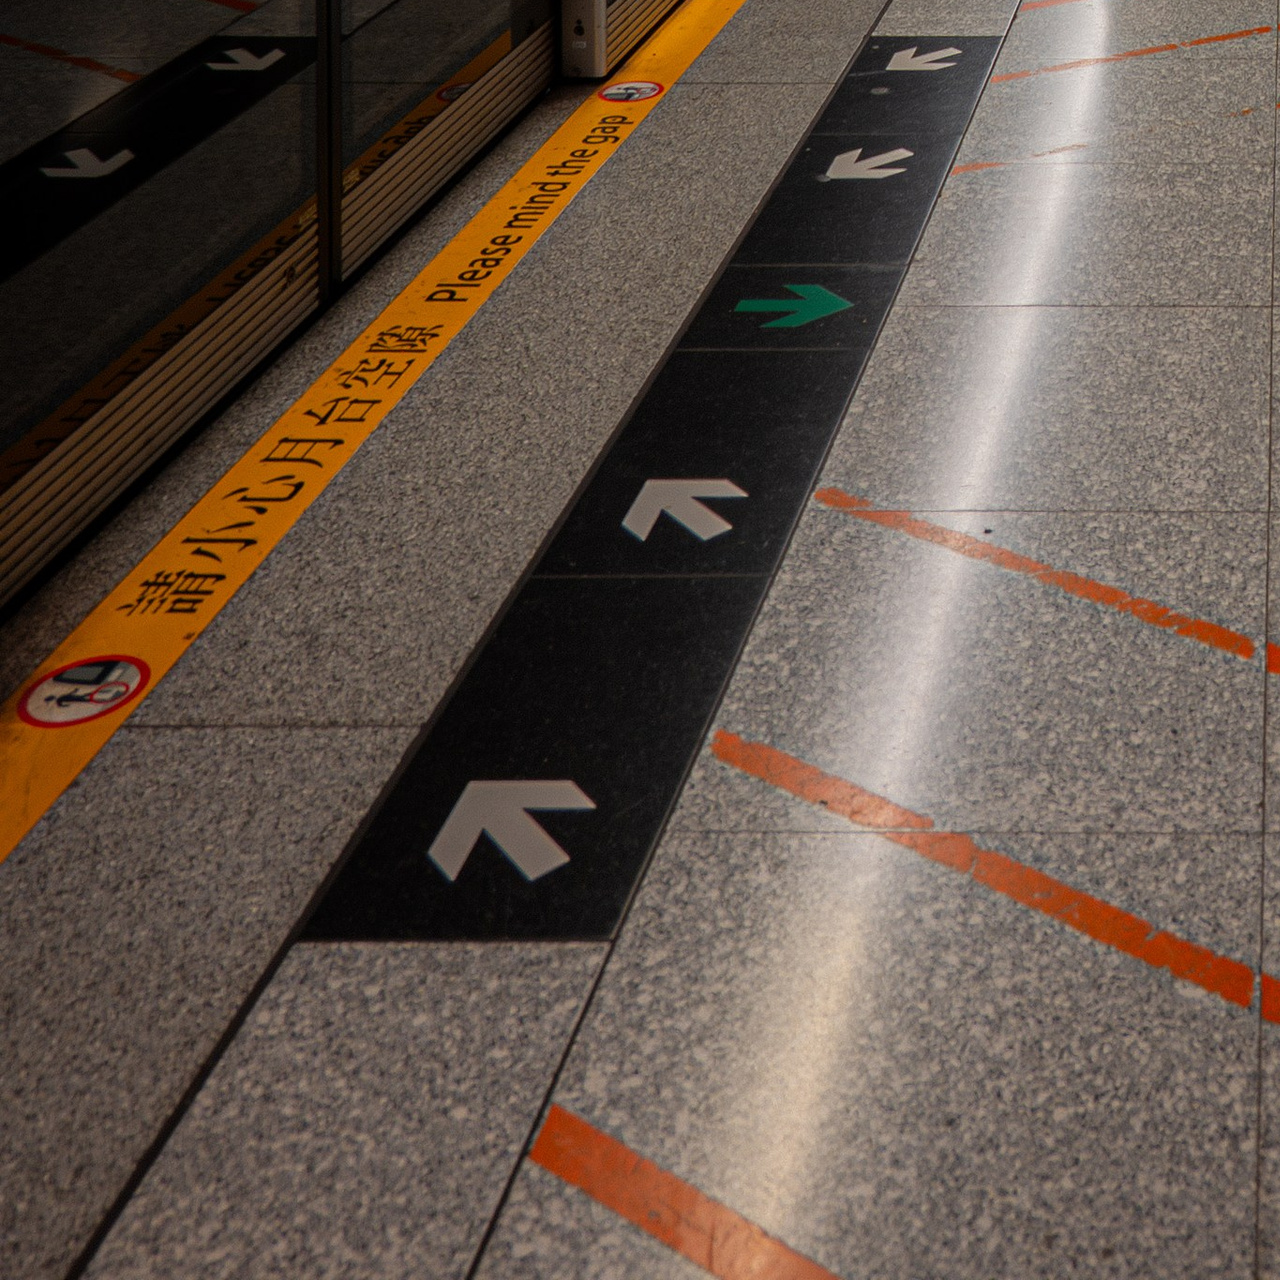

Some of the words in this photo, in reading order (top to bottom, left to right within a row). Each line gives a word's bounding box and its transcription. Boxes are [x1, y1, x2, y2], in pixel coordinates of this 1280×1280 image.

[425, 234, 523, 303] Please
[503, 181, 571, 229] mind
[546, 147, 599, 177] the
[582, 115, 634, 145] gap
[116, 324, 443, 617] 請小心月台空隙
